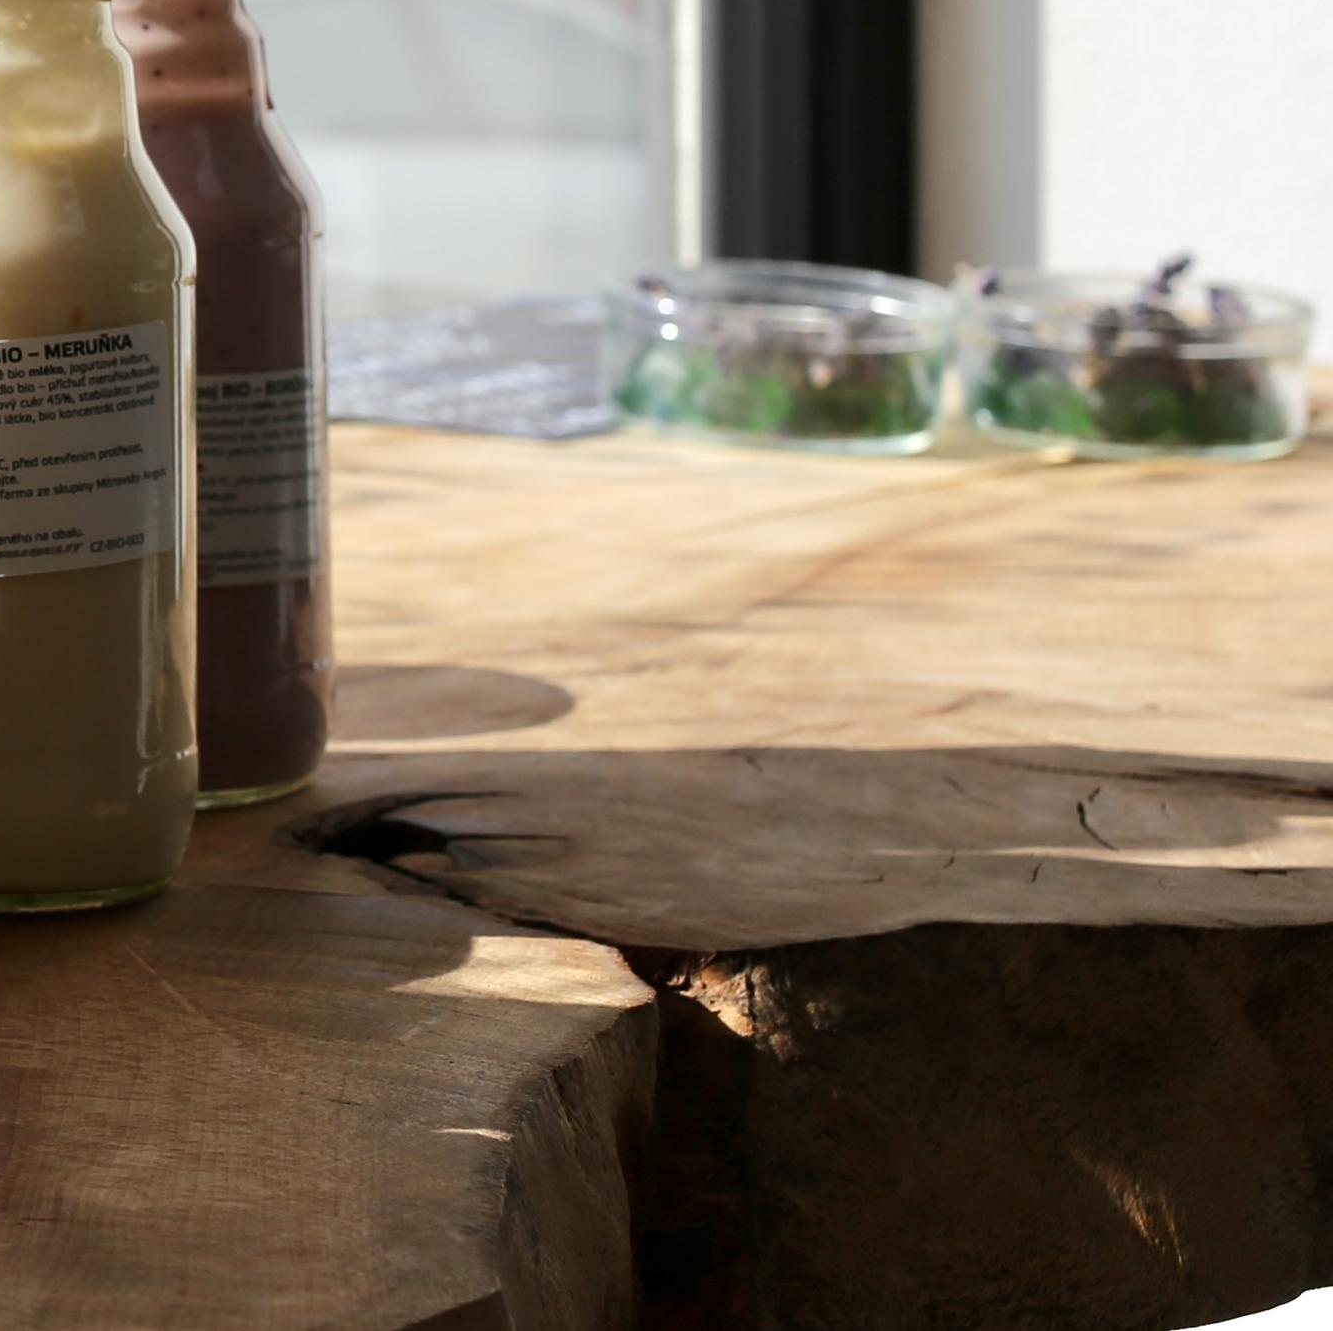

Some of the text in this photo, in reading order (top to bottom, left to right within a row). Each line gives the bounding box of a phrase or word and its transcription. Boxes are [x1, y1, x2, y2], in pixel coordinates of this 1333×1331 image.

[44, 334, 133, 360] MERUŇKA
[7, 368, 25, 379] bio
[17, 382, 35, 394] bio
[20, 397, 44, 409] cukr
[38, 410, 56, 422] bio
[37, 487, 50, 497] ze
[35, 531, 49, 541] na
